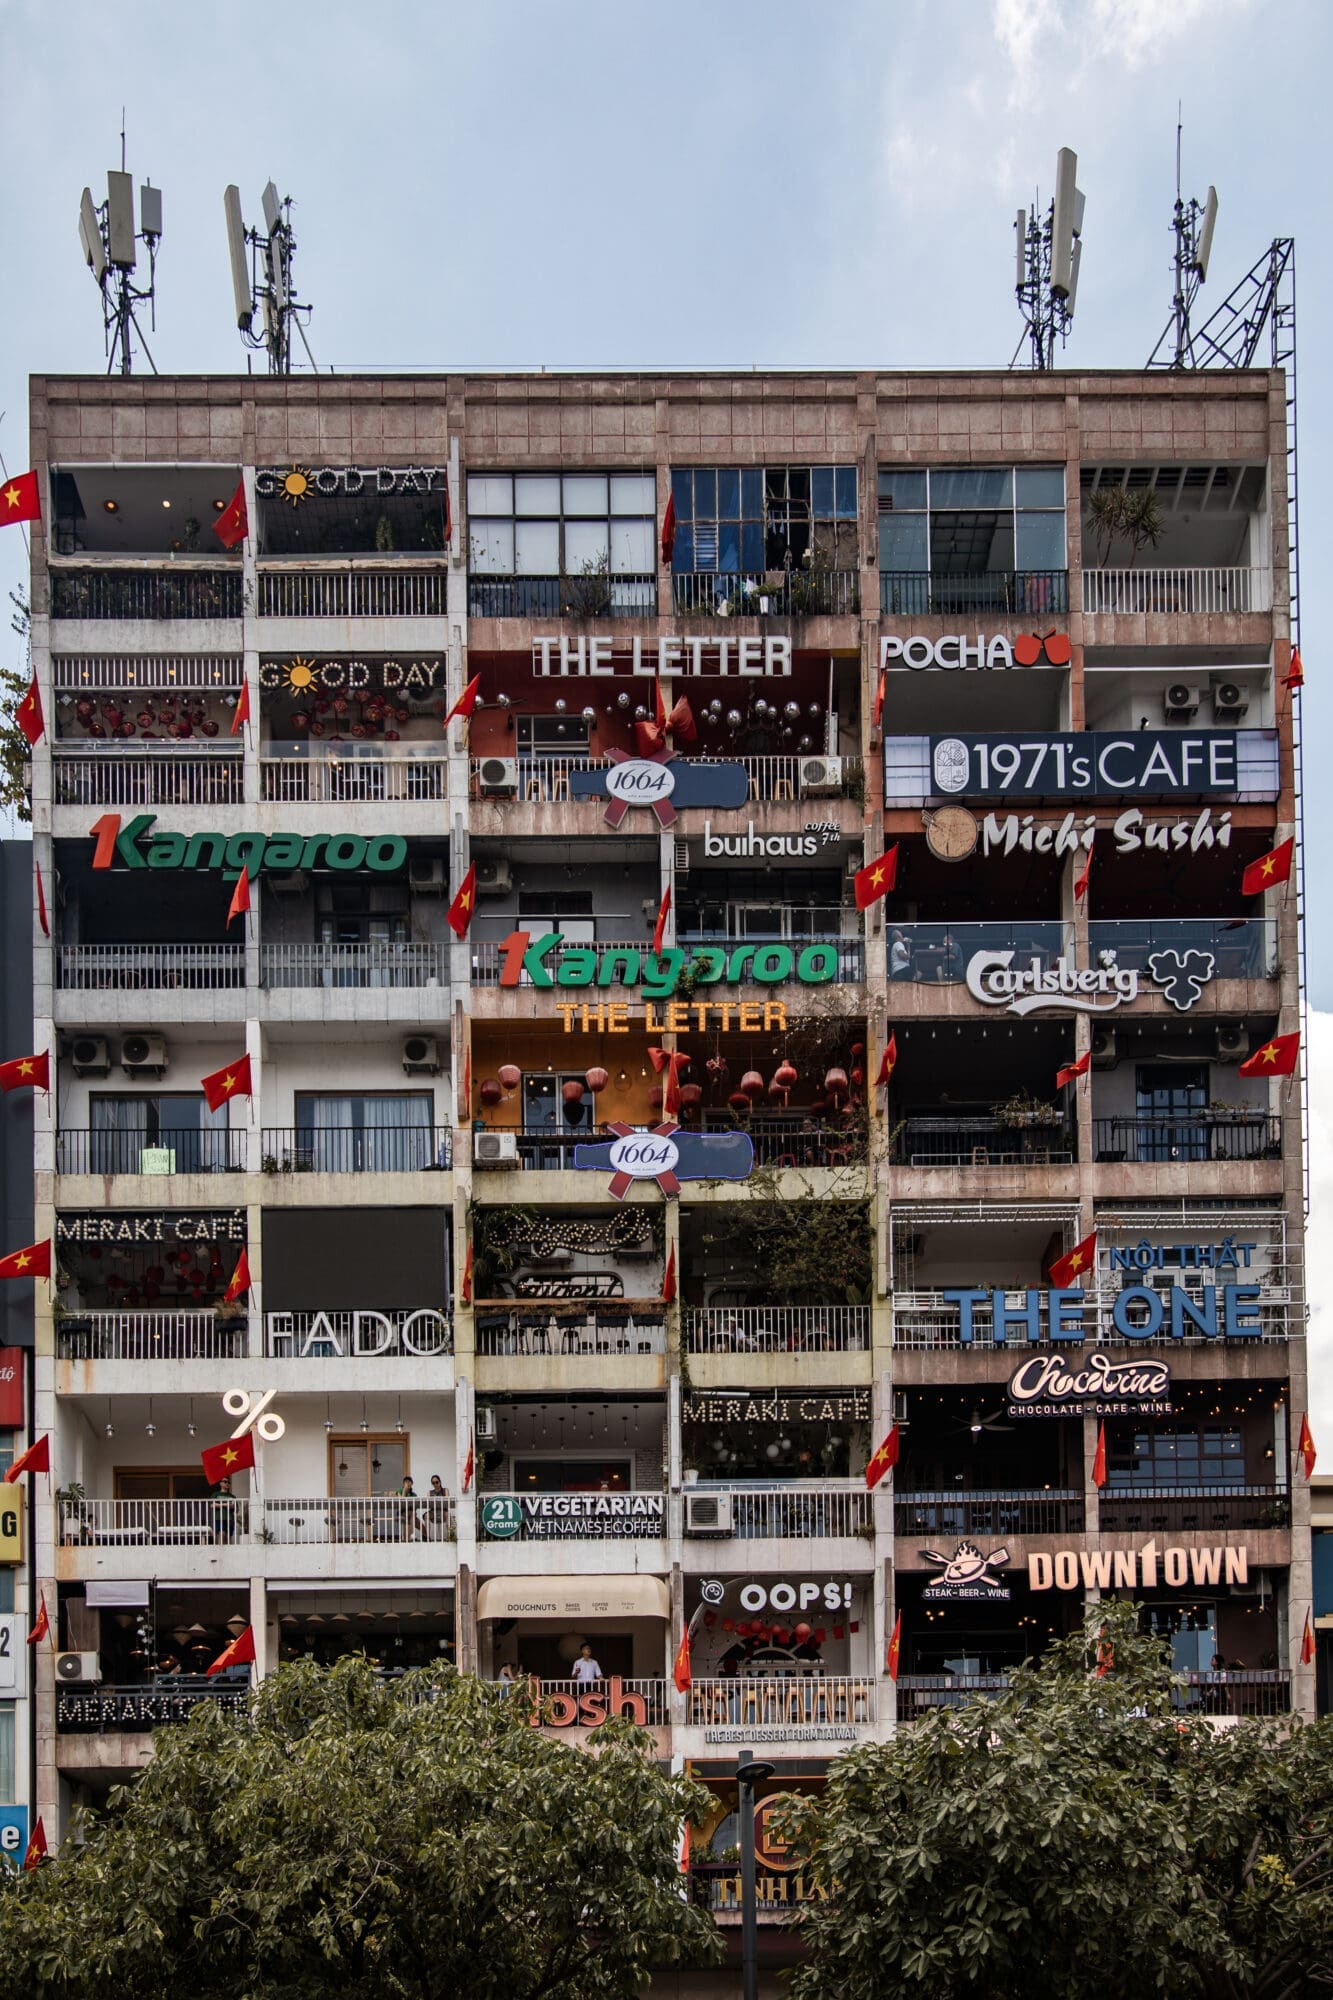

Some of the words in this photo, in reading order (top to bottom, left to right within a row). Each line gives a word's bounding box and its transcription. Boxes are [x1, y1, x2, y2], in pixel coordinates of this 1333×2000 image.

[376, 467, 438, 495] DAY
[533, 635, 615, 677] THE
[633, 635, 792, 677] LETTER
[880, 634, 1013, 669] POCHA
[383, 661, 439, 688] DAY
[1098, 740, 1235, 787] CAFE
[613, 768, 670, 791] 1664
[705, 820, 818, 857] buihaus
[804, 820, 841, 832] coffee
[822, 832, 841, 846] 7th
[982, 812, 1096, 858] Michi
[1113, 807, 1232, 856] Sushi
[966, 949, 1139, 1015] Carlsberg
[556, 1002, 630, 1033] THE
[645, 1000, 788, 1033] LETTER
[617, 1141, 674, 1164] 1664
[57, 1218, 164, 1241] MERAKI
[174, 1208, 244, 1241] CAFÉ
[1109, 1238, 1164, 1276] NỘI
[1173, 1234, 1257, 1270] THẤT
[943, 1288, 1086, 1343] THE
[1112, 1284, 1263, 1340] ONE
[267, 1308, 450, 1357] FADO
[1011, 1353, 1169, 1399] Chocowine
[682, 1399, 790, 1423] MERAKI
[799, 1389, 870, 1421] CAFÉ
[1009, 1404, 1083, 1416] CHOCOLATE
[1096, 1403, 1128, 1414] CAFE
[1140, 1402, 1173, 1413] WINE
[491, 1500, 514, 1520] 21
[526, 1497, 664, 1516] VEGETARIAN
[486, 1520, 519, 1529] Grams
[507, 1603, 557, 1612] DOUGHNUTS
[740, 1582, 852, 1612] OOPS!
[925, 1588, 952, 1598] STEAK
[959, 1588, 979, 1598] BEER
[987, 1588, 1010, 1598] WINE
[58, 1695, 169, 1723] MERAKI
[705, 1730, 722, 1743] THE
[724, 1730, 747, 1743] BEST
[750, 1729, 790, 1742] DESSERT
[792, 1728, 818, 1741] FORM
[820, 1727, 859, 1741] TAIWAN
